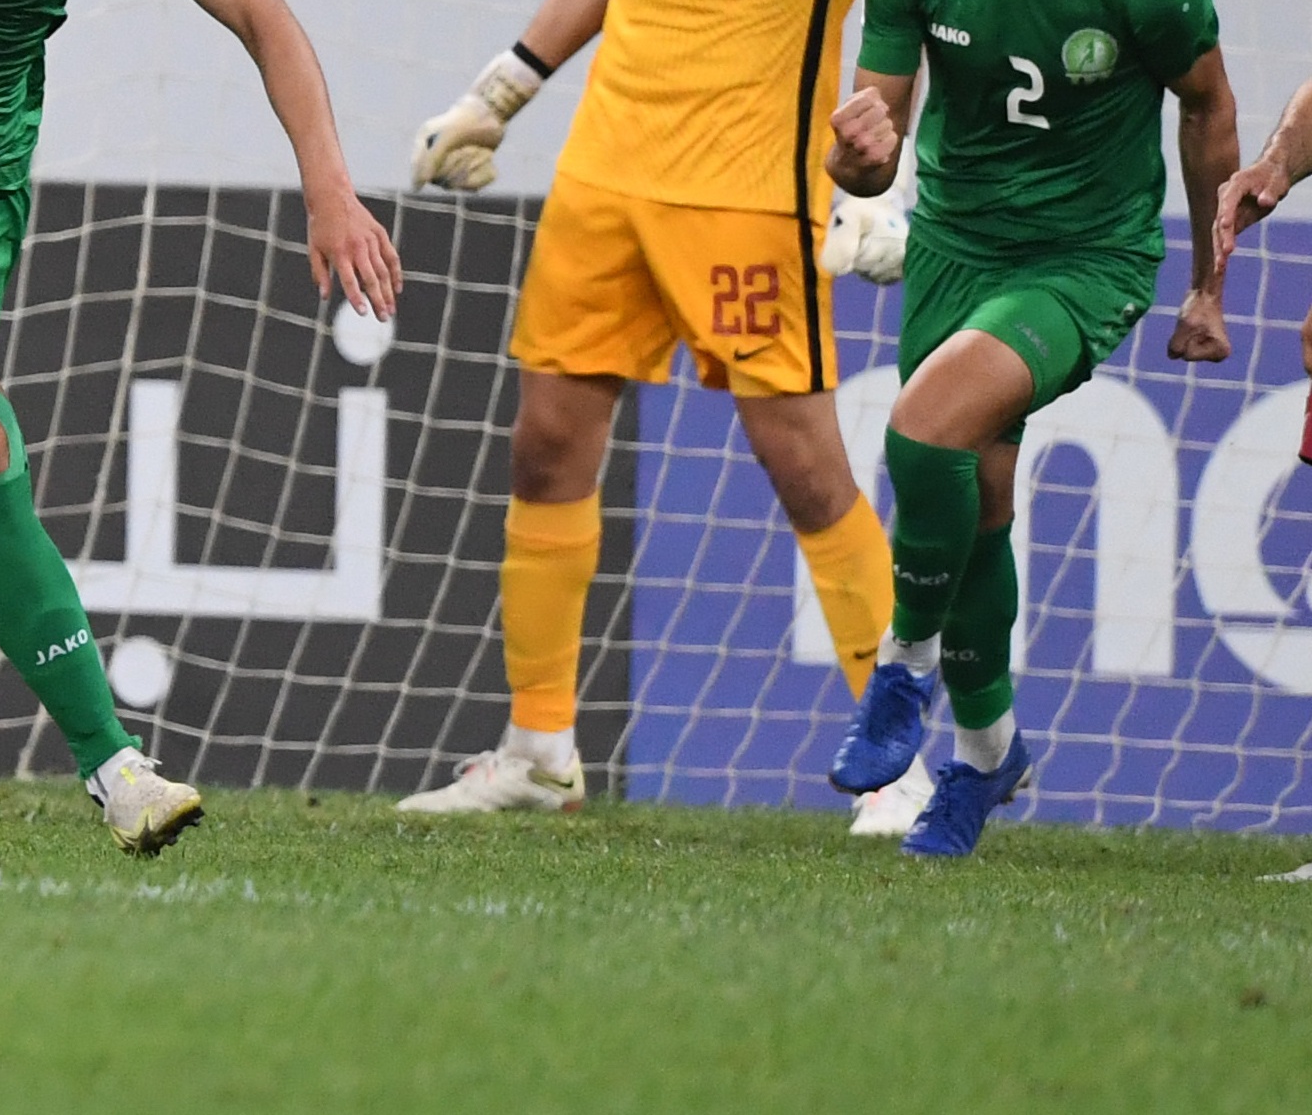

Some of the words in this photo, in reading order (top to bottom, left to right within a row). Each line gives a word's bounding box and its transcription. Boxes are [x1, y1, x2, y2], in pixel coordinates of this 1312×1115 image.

[1006, 55, 1051, 130] 2
[709, 264, 781, 336] 22
[35, 628, 89, 666] JAKO
